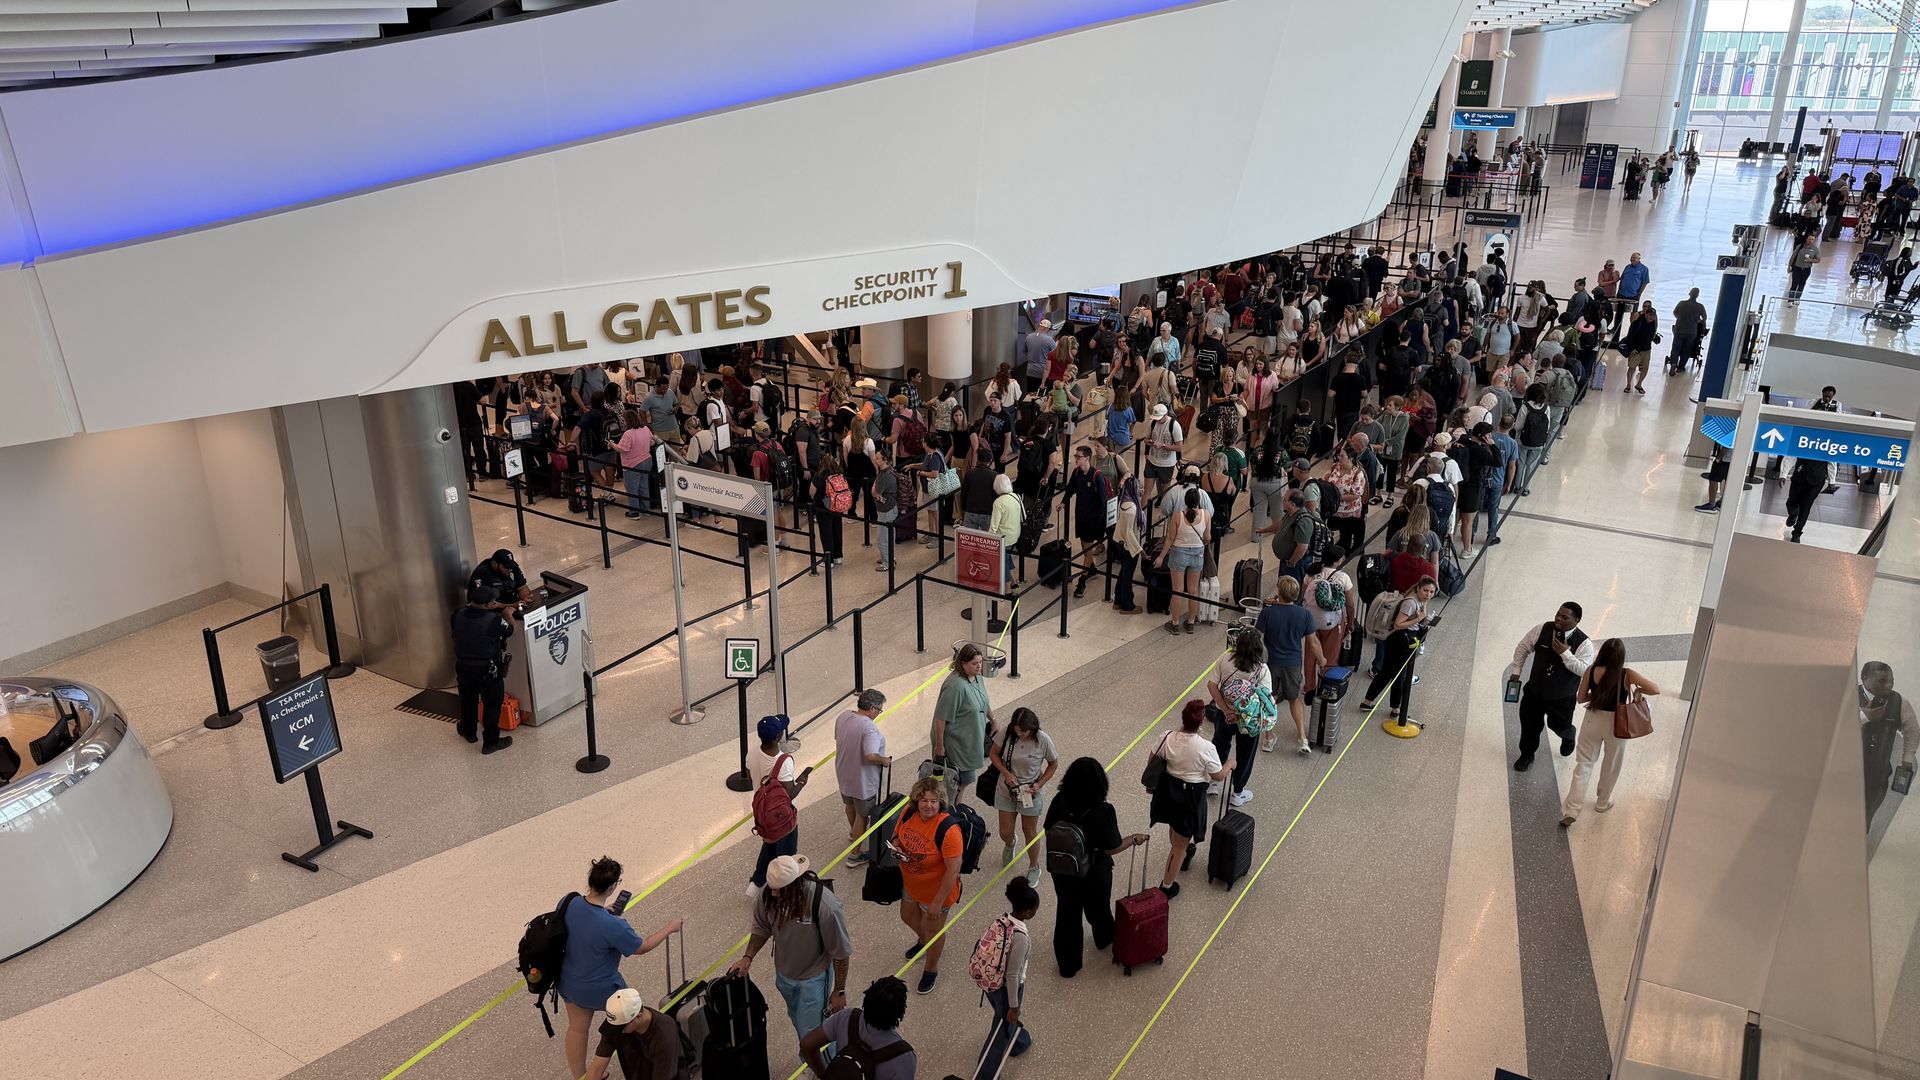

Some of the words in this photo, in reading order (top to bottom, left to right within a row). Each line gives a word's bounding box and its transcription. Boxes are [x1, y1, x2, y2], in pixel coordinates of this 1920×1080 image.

[854, 267, 939, 290] SECURITY
[944, 261, 967, 299] 1
[822, 284, 938, 311] CHECKPOINT
[480, 311, 588, 362] ALL
[602, 285, 772, 344] GATES
[1798, 436, 1848, 455] Bridge
[1854, 445, 1871, 456] to
[692, 482, 725, 495] Wheelchair
[725, 490, 744, 500] Access
[970, 537, 999, 546] FIREARMS
[537, 606, 577, 636] POLICE
[270, 713, 280, 722] At
[280, 693, 319, 717] Checkpoint
[278, 696, 294, 707] TSA
[294, 690, 306, 700] Pre
[288, 713, 315, 734] KCM
